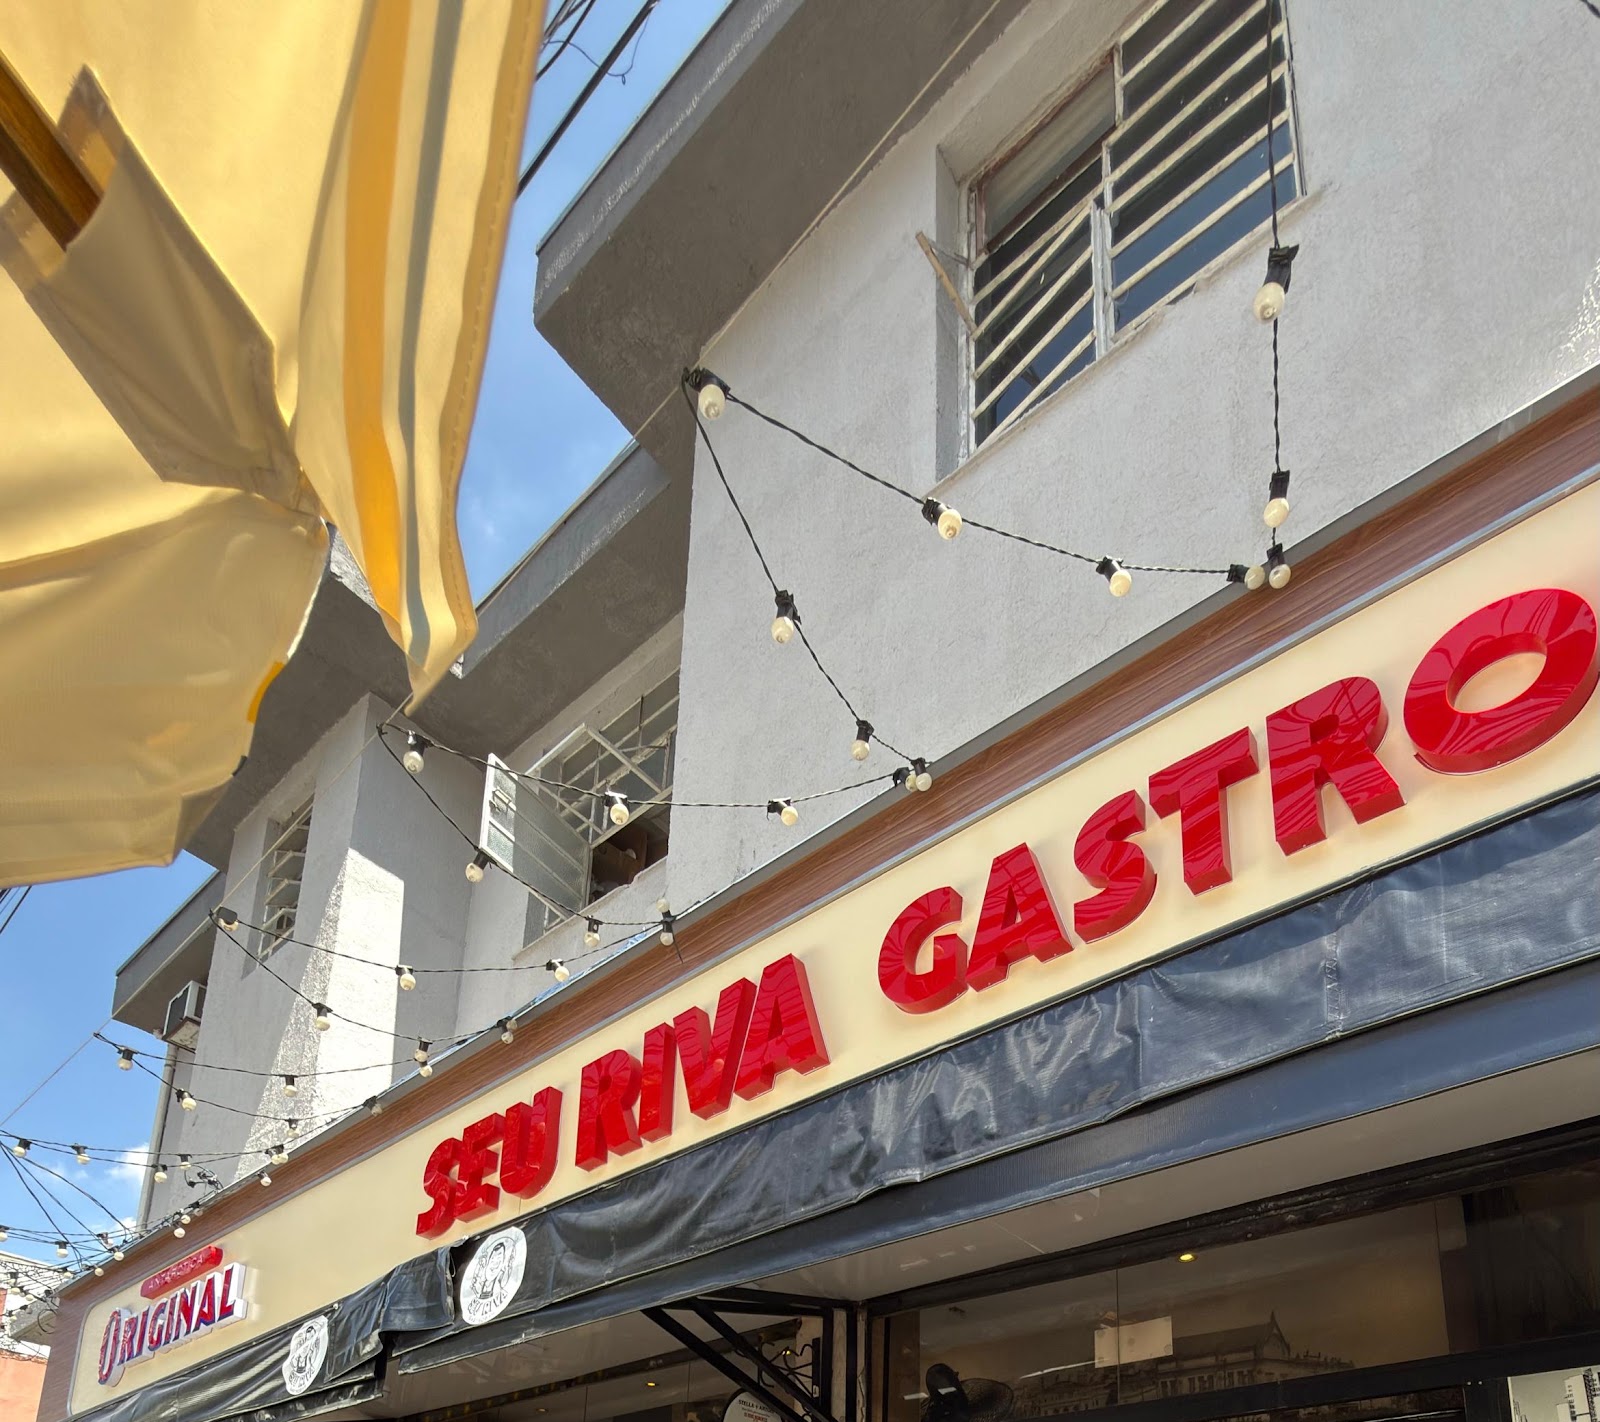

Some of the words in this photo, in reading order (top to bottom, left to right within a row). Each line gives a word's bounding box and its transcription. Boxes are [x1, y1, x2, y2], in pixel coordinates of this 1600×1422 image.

[415, 1086, 563, 1240] SEU
[575, 953, 833, 1176] RIVA
[877, 587, 1600, 1015] GASTRO
[97, 1262, 248, 1388] ORIGINAL
[738, 1400, 756, 1409] STELLA
